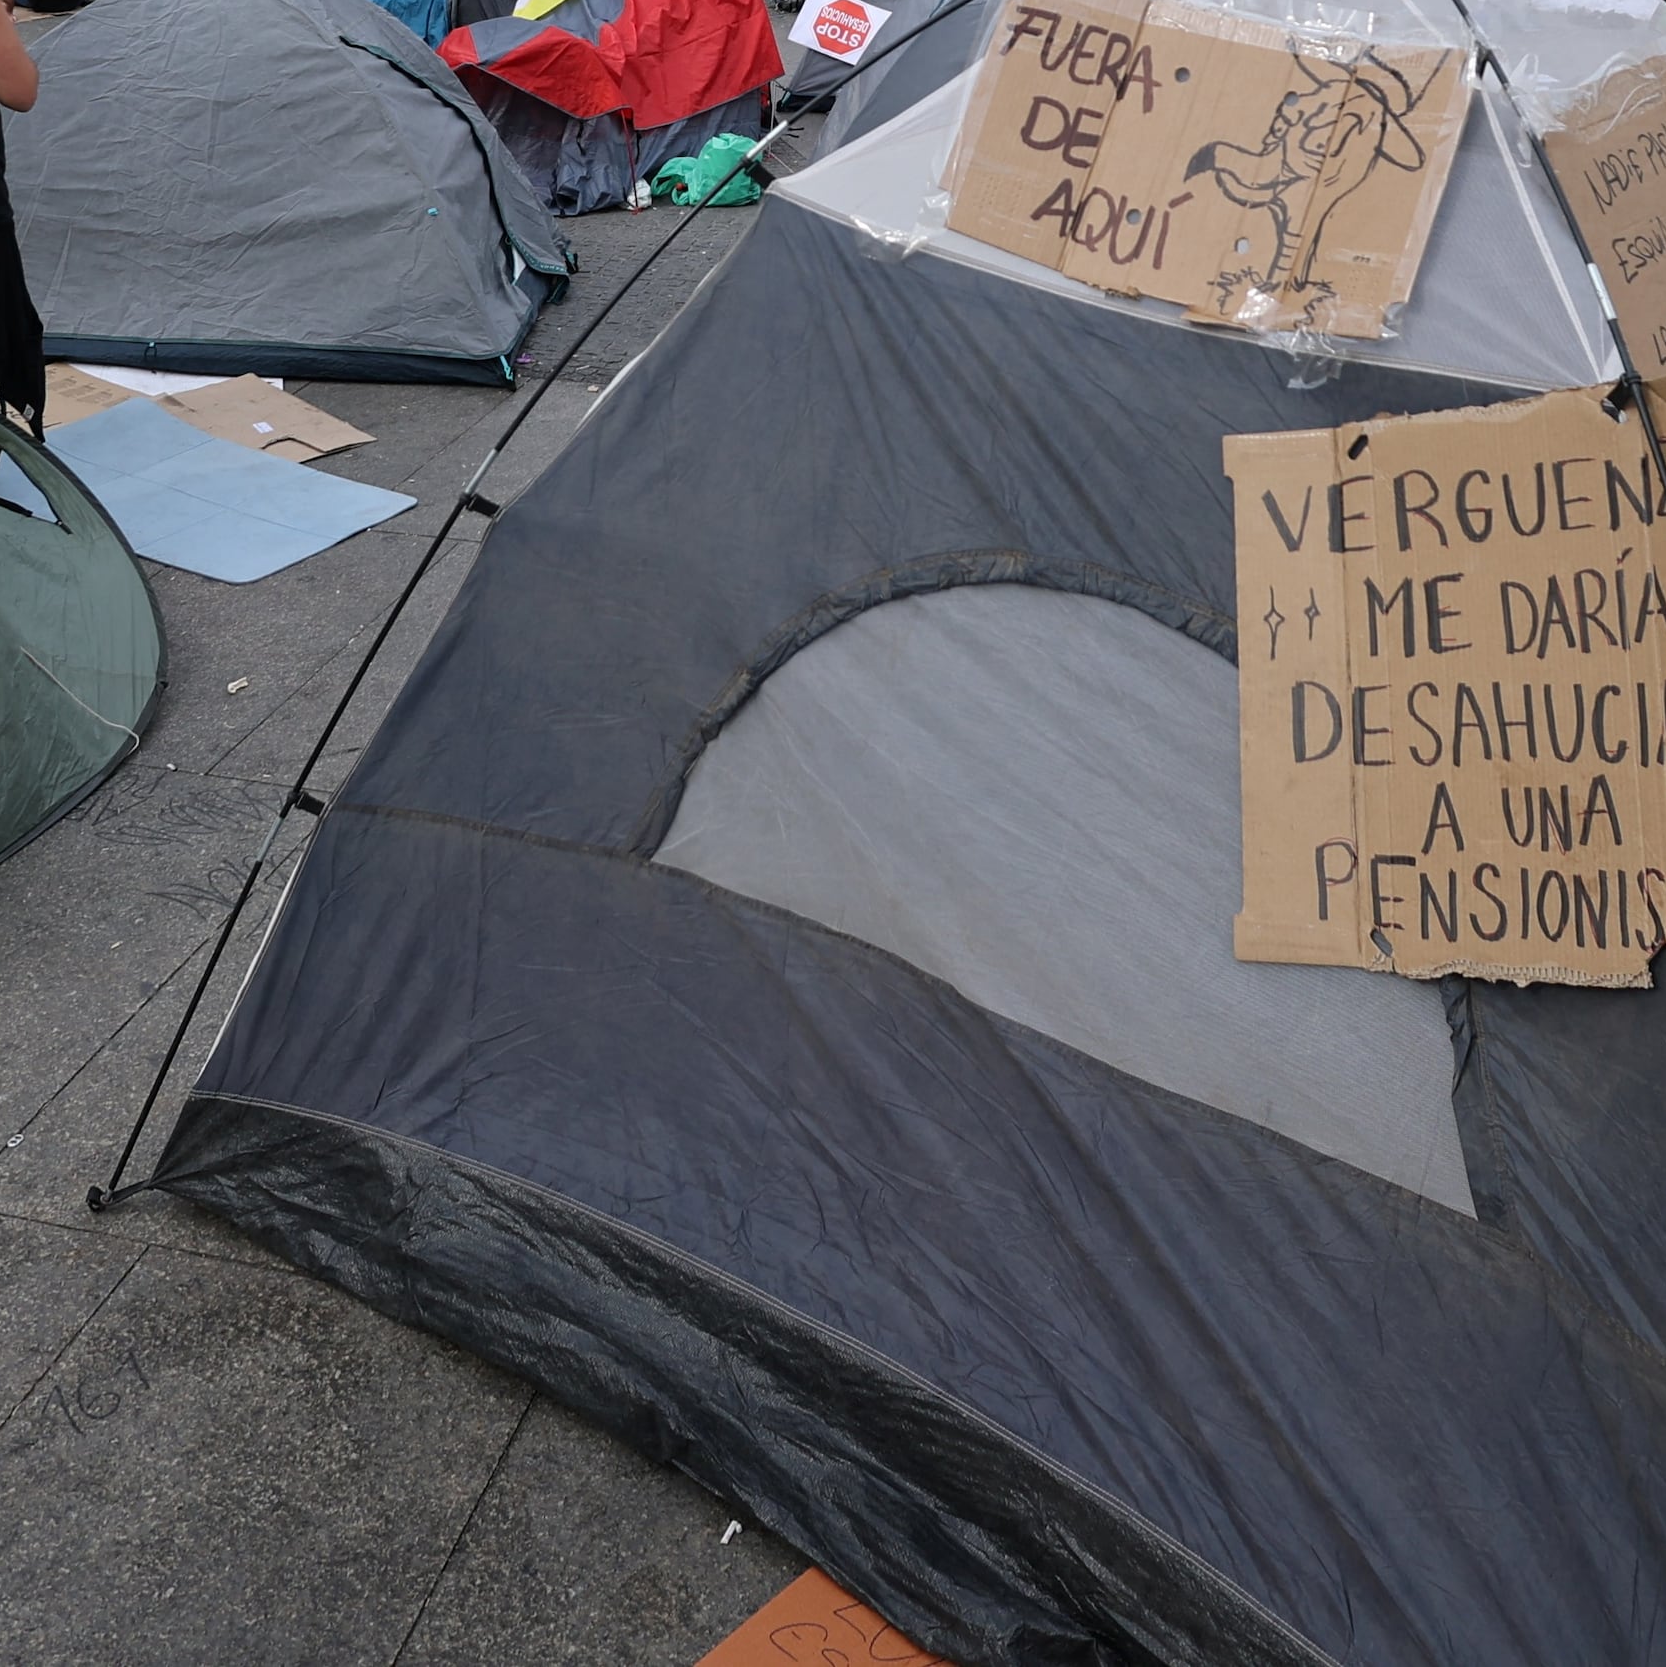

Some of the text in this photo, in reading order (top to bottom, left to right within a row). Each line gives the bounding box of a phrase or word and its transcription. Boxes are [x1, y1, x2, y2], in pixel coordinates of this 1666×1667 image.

[816, 22, 861, 47] STOP
[821, 6, 870, 34] DESAHUCIOS
[1000, 5, 1162, 114] FUERA
[1021, 96, 1105, 168] DE
[1032, 179, 1194, 271] AQUÍ
[1365, 574, 1471, 658] ME
[1422, 774, 1622, 855] A UNA
